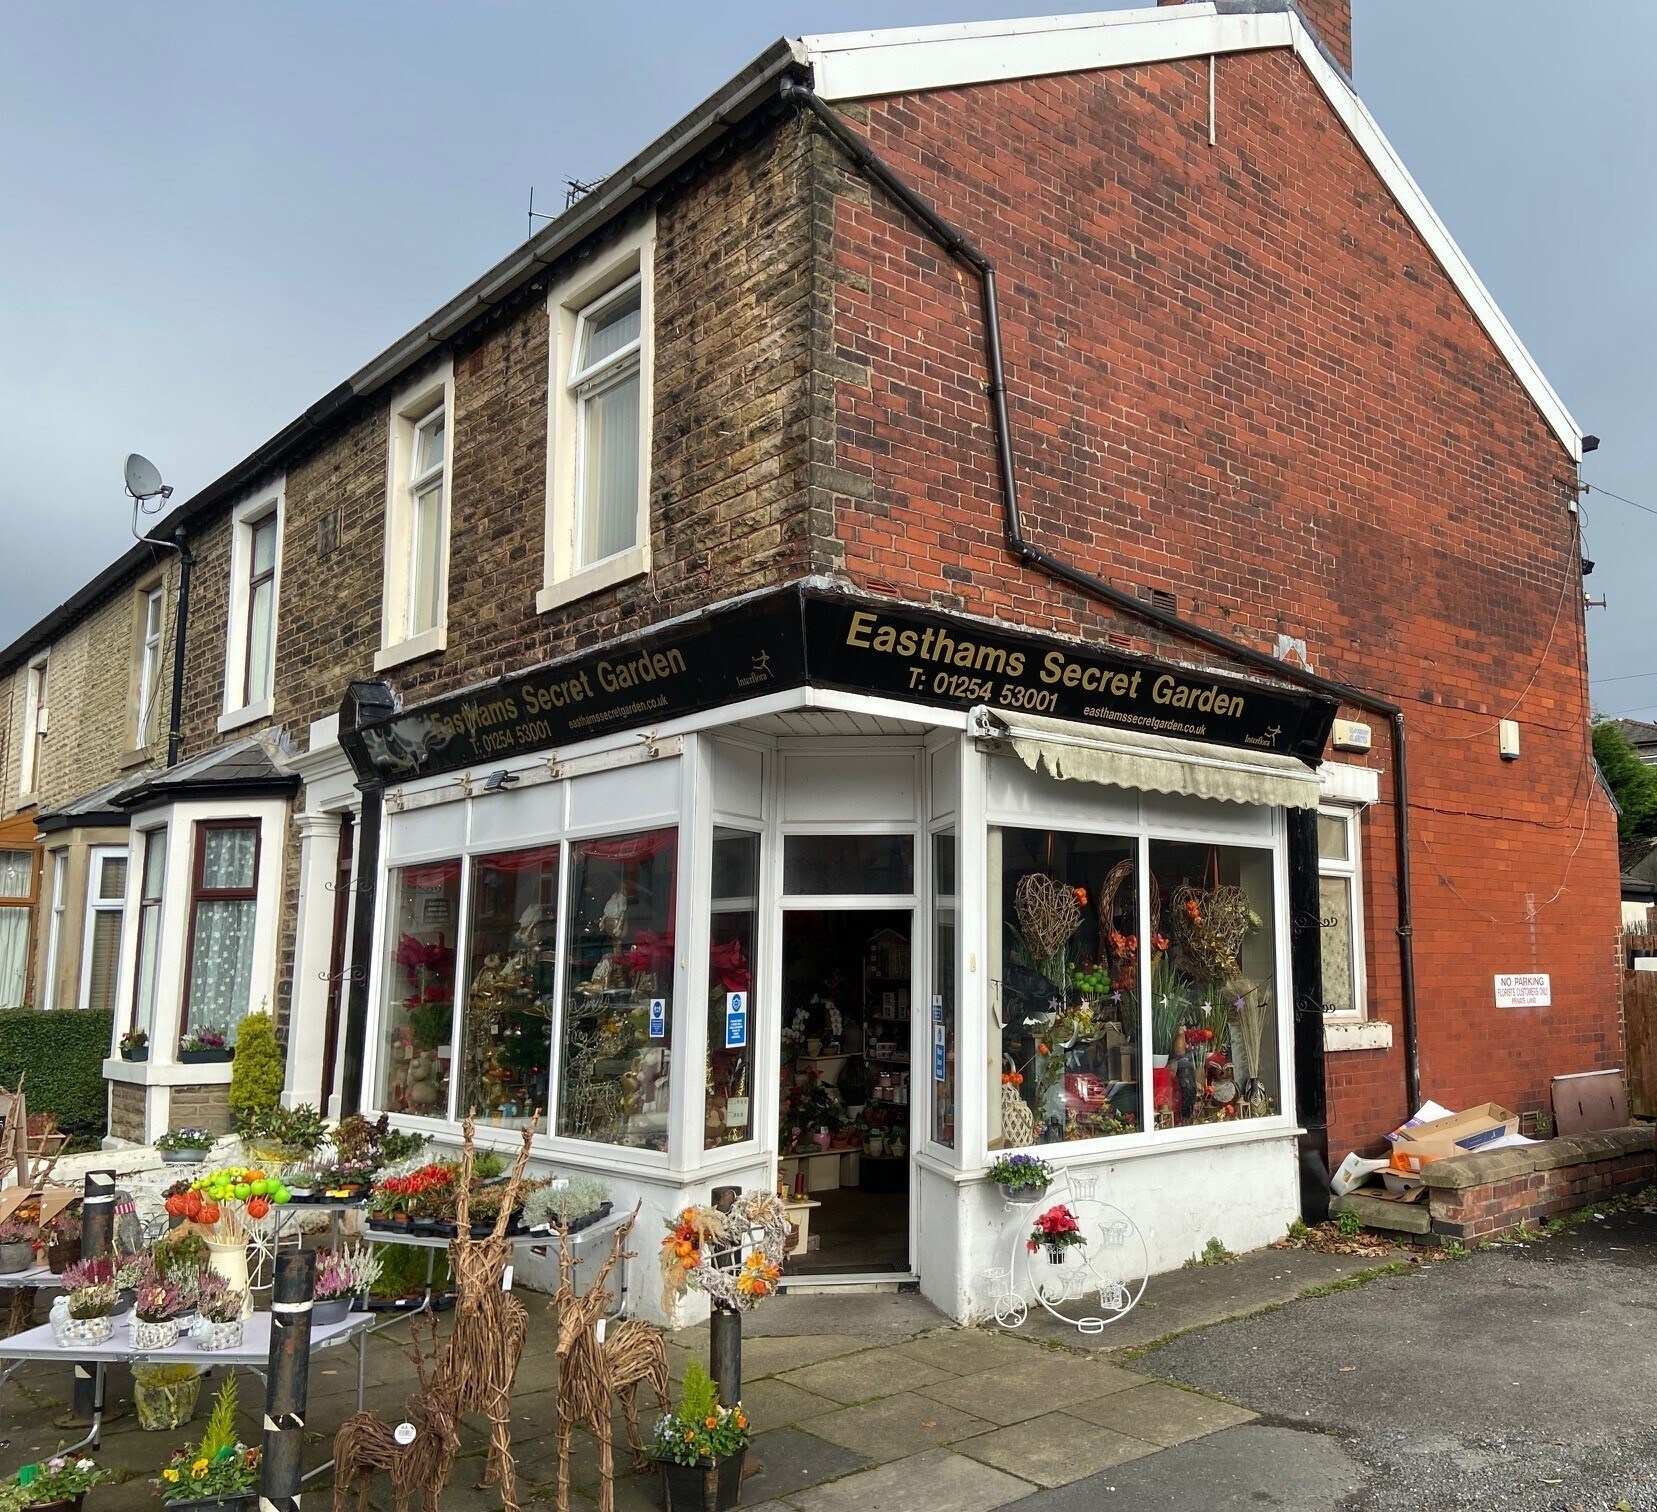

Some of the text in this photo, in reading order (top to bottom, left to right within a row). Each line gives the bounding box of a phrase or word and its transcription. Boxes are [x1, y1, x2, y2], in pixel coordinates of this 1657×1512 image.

[846, 611, 1245, 718] Easthams Secret Garden
[430, 648, 687, 739] Easthams Secret Garden
[909, 667, 1059, 712] T: 01254 53001
[568, 694, 668, 730] easthamssecretgarden.co.uk
[1083, 705, 1206, 736] easthamssecretgarden.co.uk
[482, 729, 515, 752] 01254
[516, 719, 552, 744] 53001
[1501, 976, 1544, 986] NO PARKING
